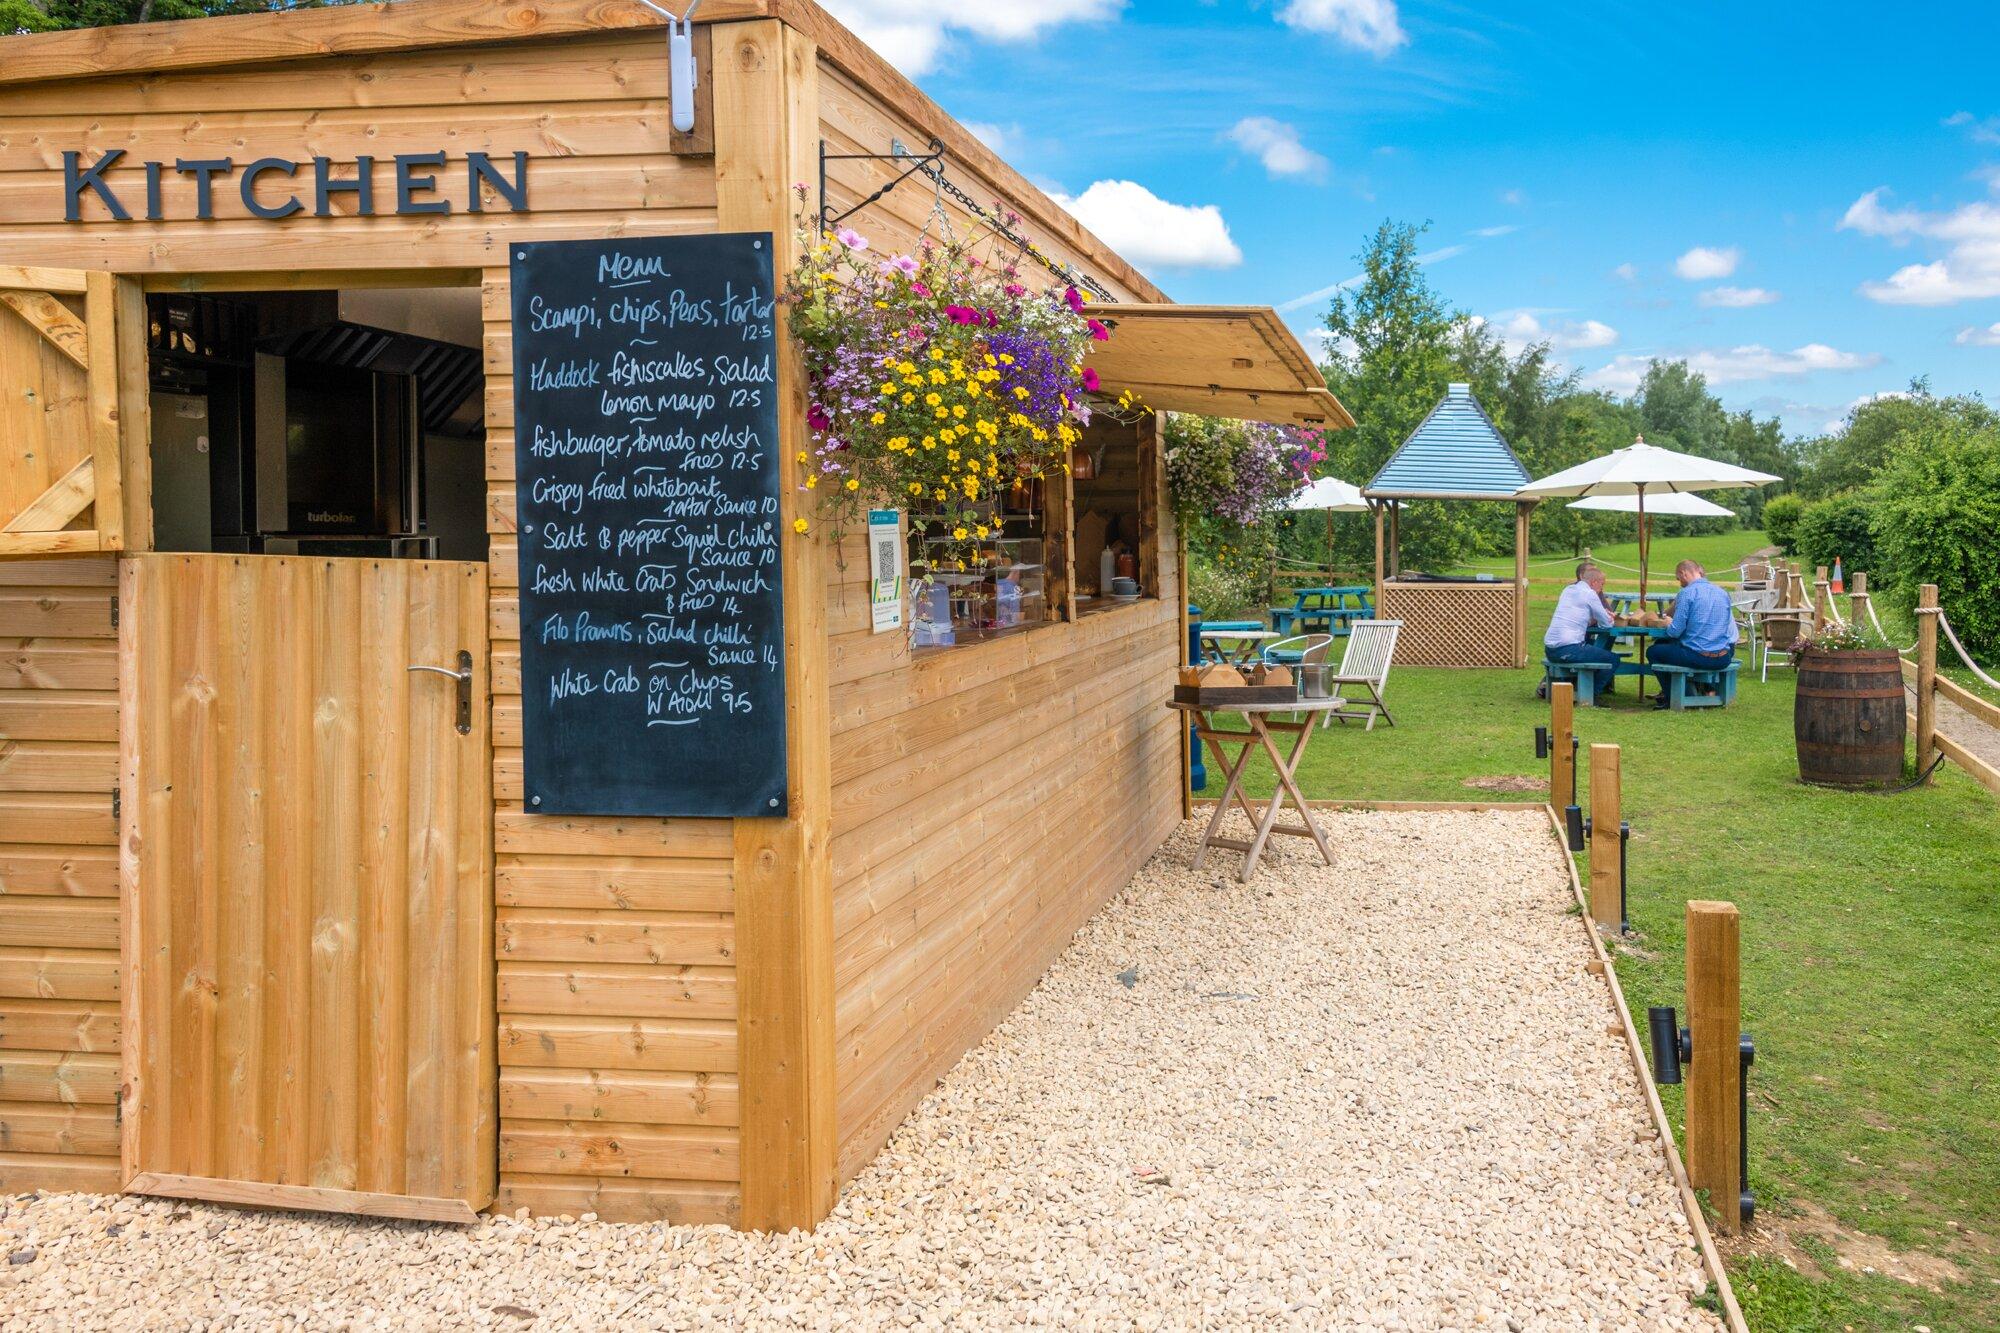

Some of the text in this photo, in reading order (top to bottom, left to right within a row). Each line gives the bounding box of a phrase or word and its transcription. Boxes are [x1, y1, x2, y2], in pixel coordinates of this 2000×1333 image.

[62, 149, 530, 222] KITCHEN
[599, 253, 671, 283] Menu
[531, 358, 600, 391] Haddock
[715, 354, 773, 385] Salad
[601, 390, 653, 416] lemon
[658, 394, 715, 419] mayo
[632, 426, 695, 452] tomato
[701, 425, 760, 449] relish
[533, 476, 583, 514] Crispy
[588, 472, 626, 500] fried
[761, 496, 777, 513] 10
[544, 523, 587, 550] Salt
[618, 528, 671, 556] pepper
[759, 548, 775, 565] 10
[636, 568, 675, 592] Crab
[723, 597, 742, 616] 14
[647, 616, 696, 644] Salad
[764, 645, 778, 671] 14
[551, 668, 597, 704] White
[604, 666, 640, 693] Crab
[649, 675, 671, 694] on
[648, 690, 663, 715] W
